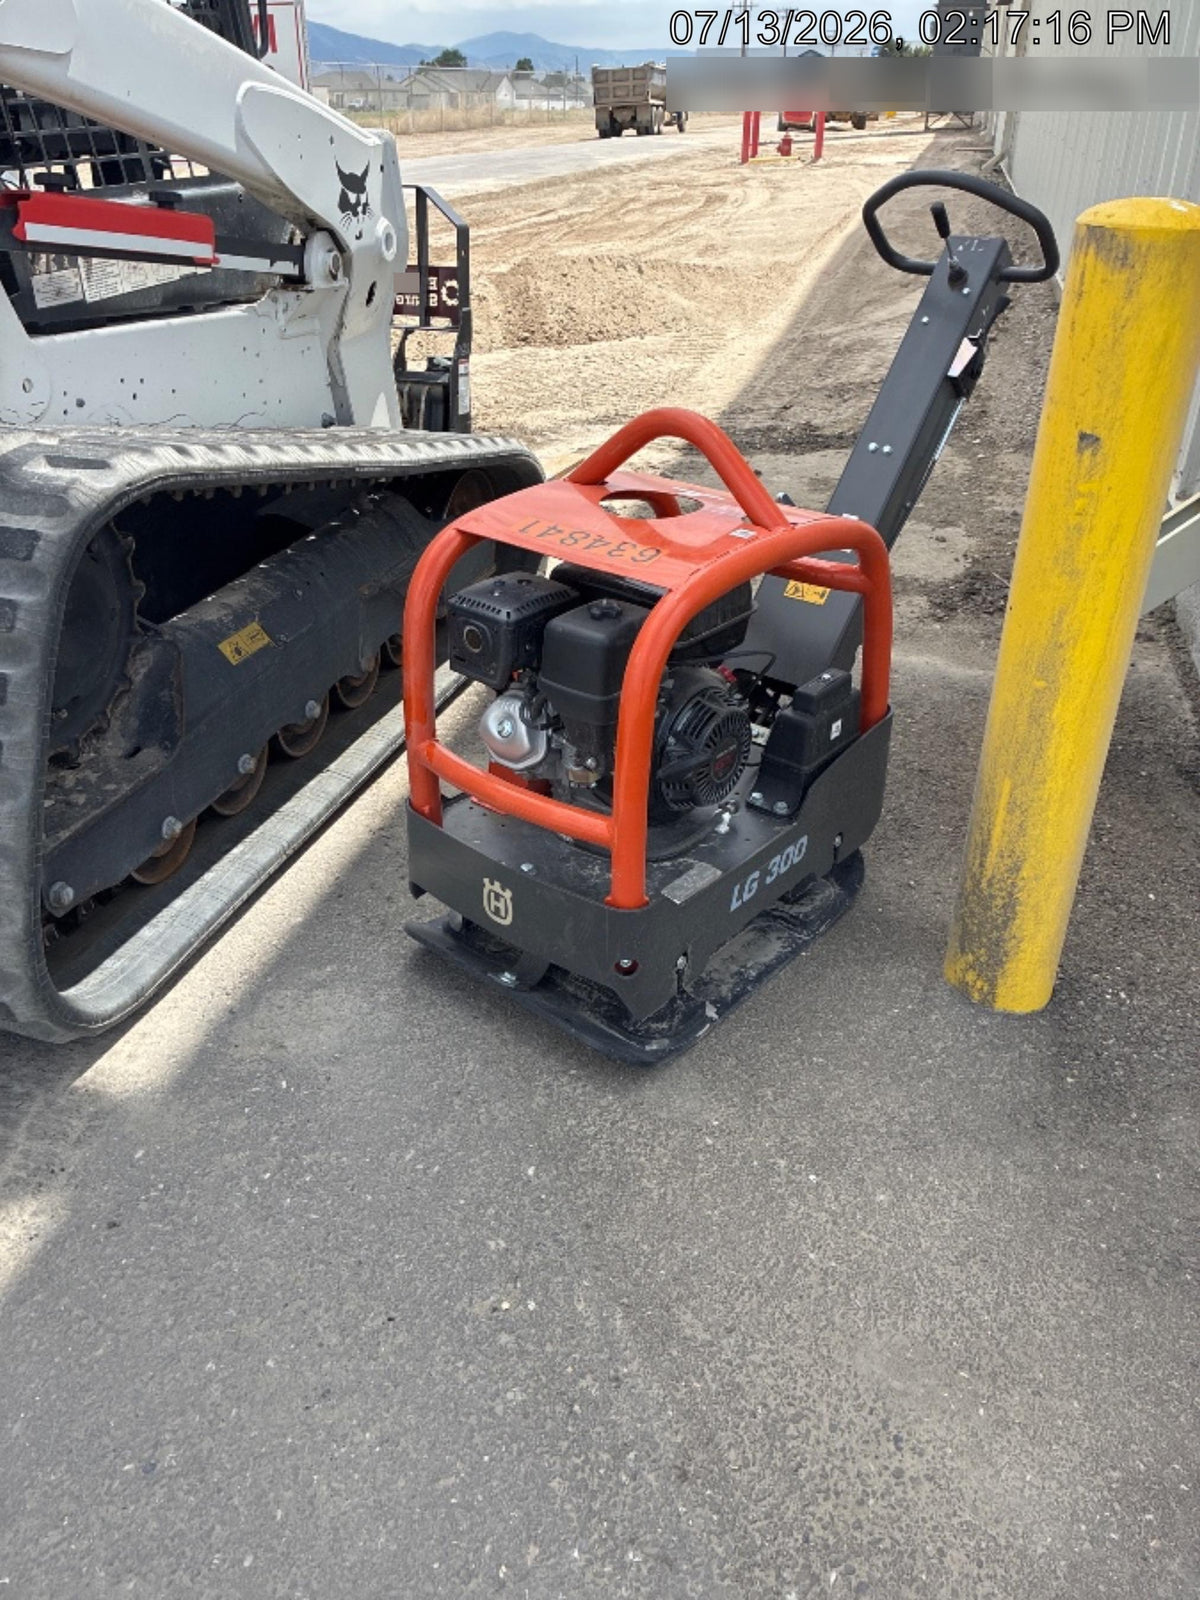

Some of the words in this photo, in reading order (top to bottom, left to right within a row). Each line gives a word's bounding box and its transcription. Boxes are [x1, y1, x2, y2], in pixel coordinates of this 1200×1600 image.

[518, 520, 662, 563] 634841
[730, 869, 760, 912] LG
[765, 835, 808, 885] 300
